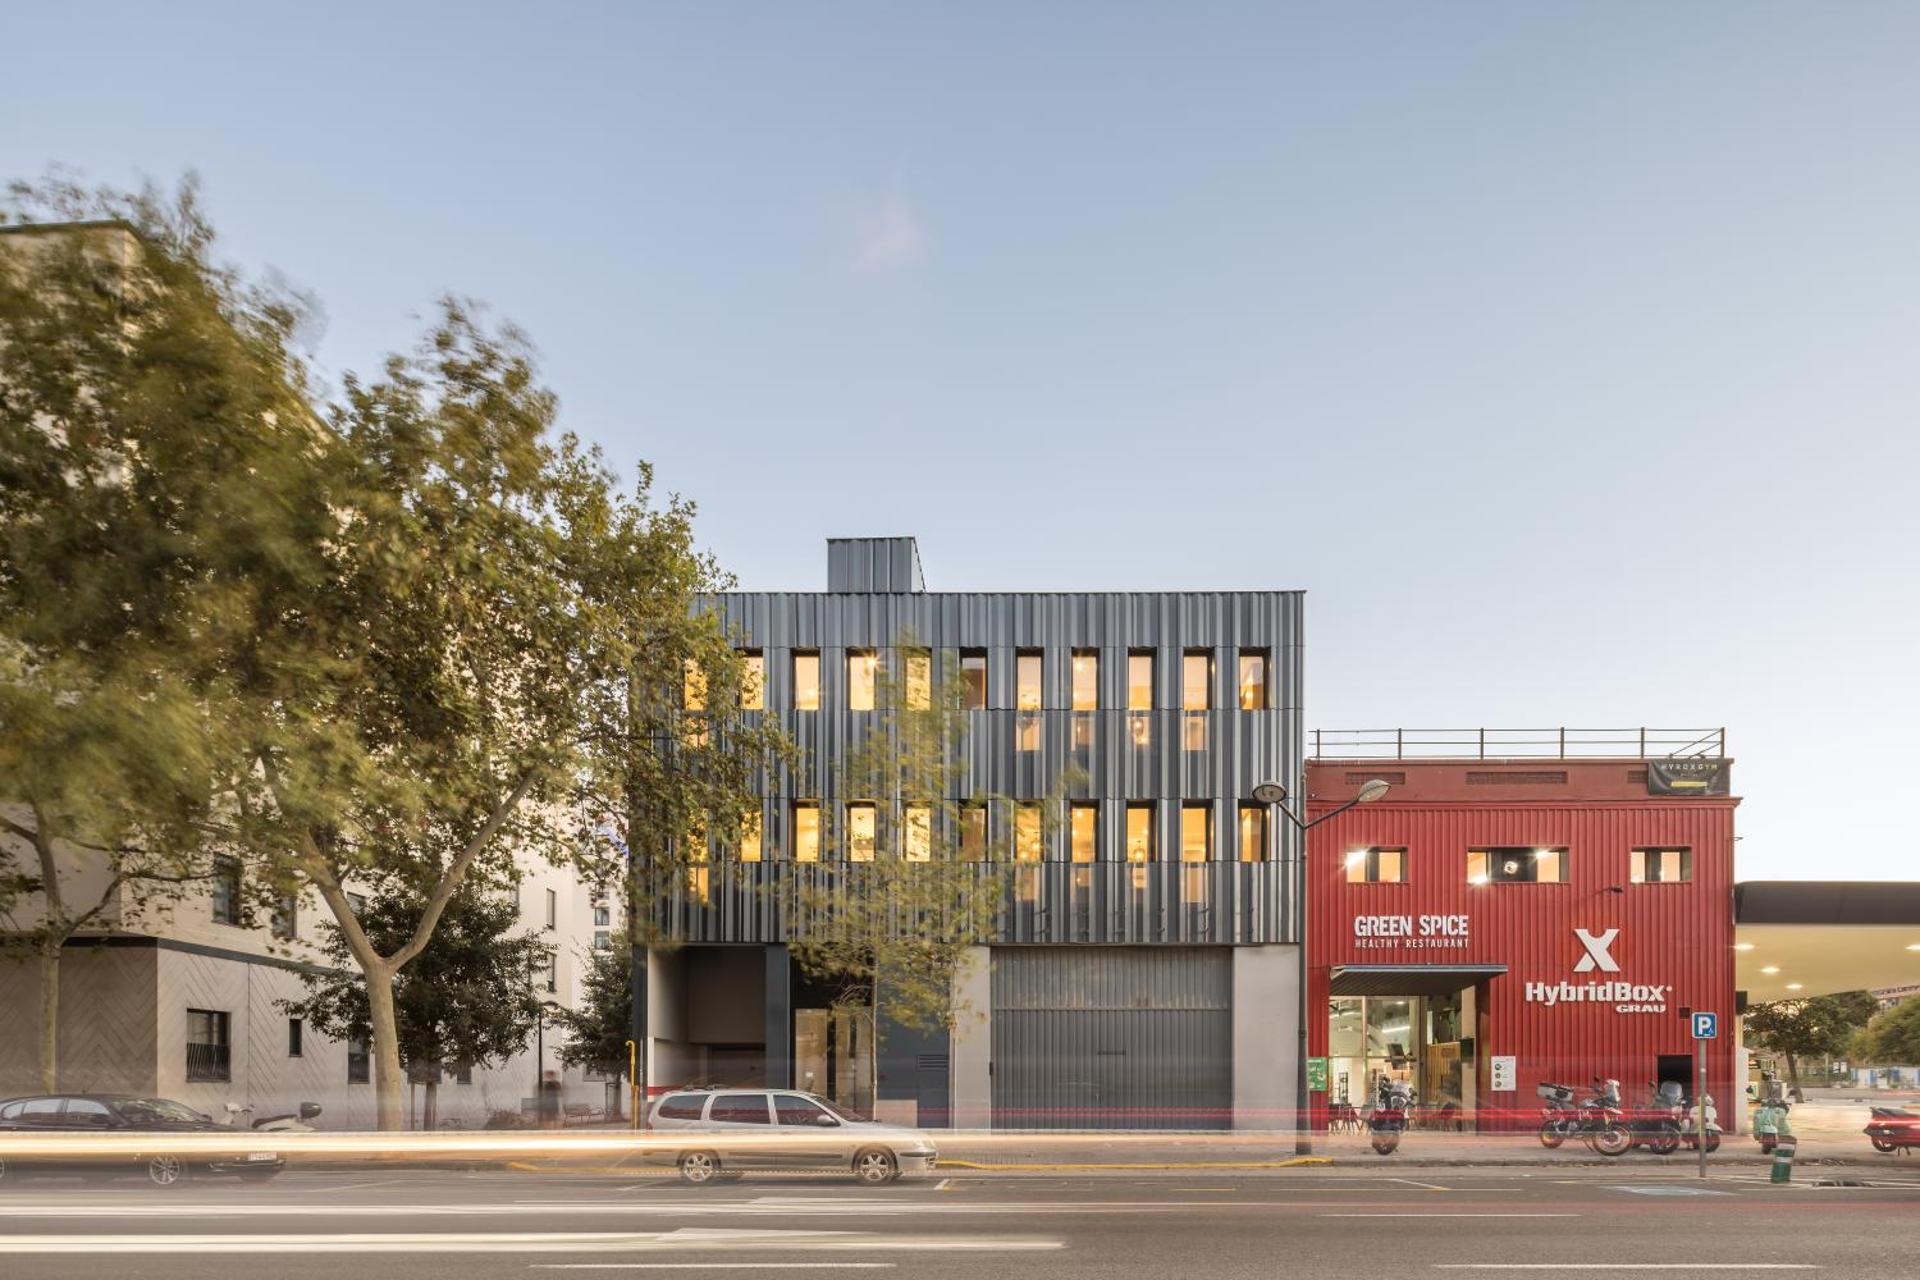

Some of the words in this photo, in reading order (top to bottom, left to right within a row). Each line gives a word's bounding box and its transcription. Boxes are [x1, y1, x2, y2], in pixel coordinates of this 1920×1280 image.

[1354, 915, 1413, 937] GREEN
[1419, 914, 1469, 936] SPICE
[1355, 938, 1399, 949] HEALTHY
[1406, 938, 1469, 949] RESTAURANT
[1525, 981, 1665, 1006] HybridBox
[1616, 1004, 1667, 1013] GRAU
[1698, 1016, 1712, 1035] P
